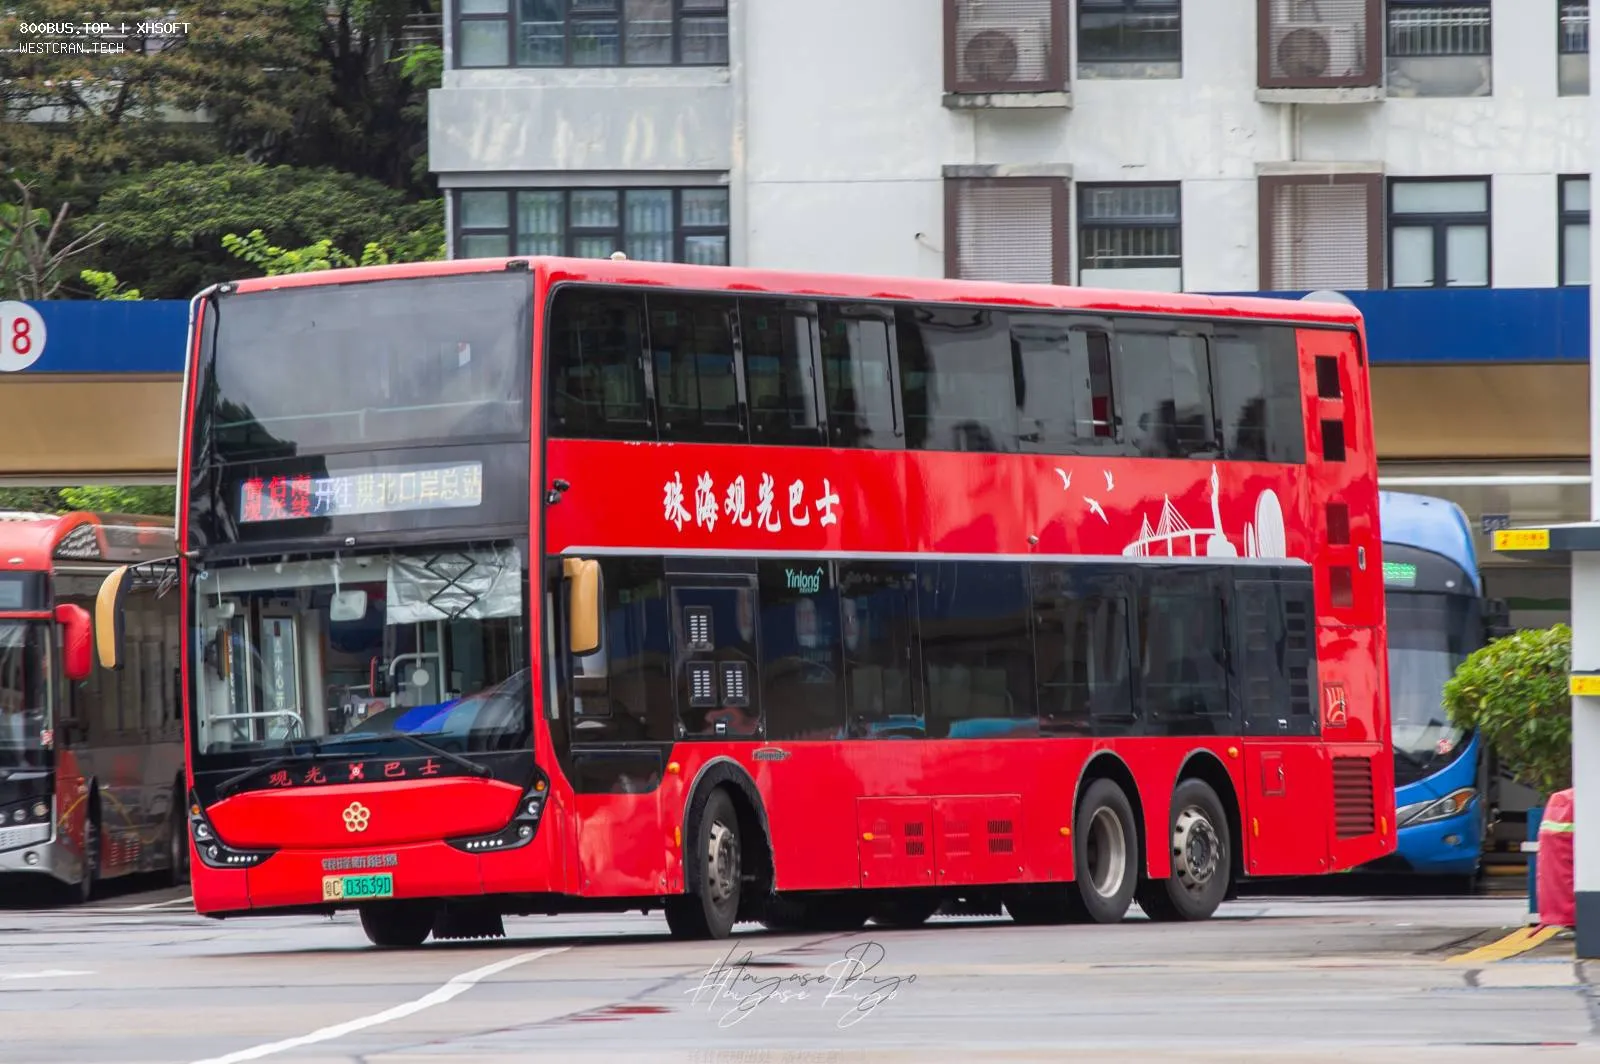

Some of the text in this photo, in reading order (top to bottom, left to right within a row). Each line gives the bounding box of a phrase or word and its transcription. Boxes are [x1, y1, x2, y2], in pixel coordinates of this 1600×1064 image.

[0, 316, 32, 355] 8
[663, 470, 841, 533] 珠海观光巴士
[785, 567, 822, 593] Yinlong
[268, 756, 442, 787] 观光 巴士
